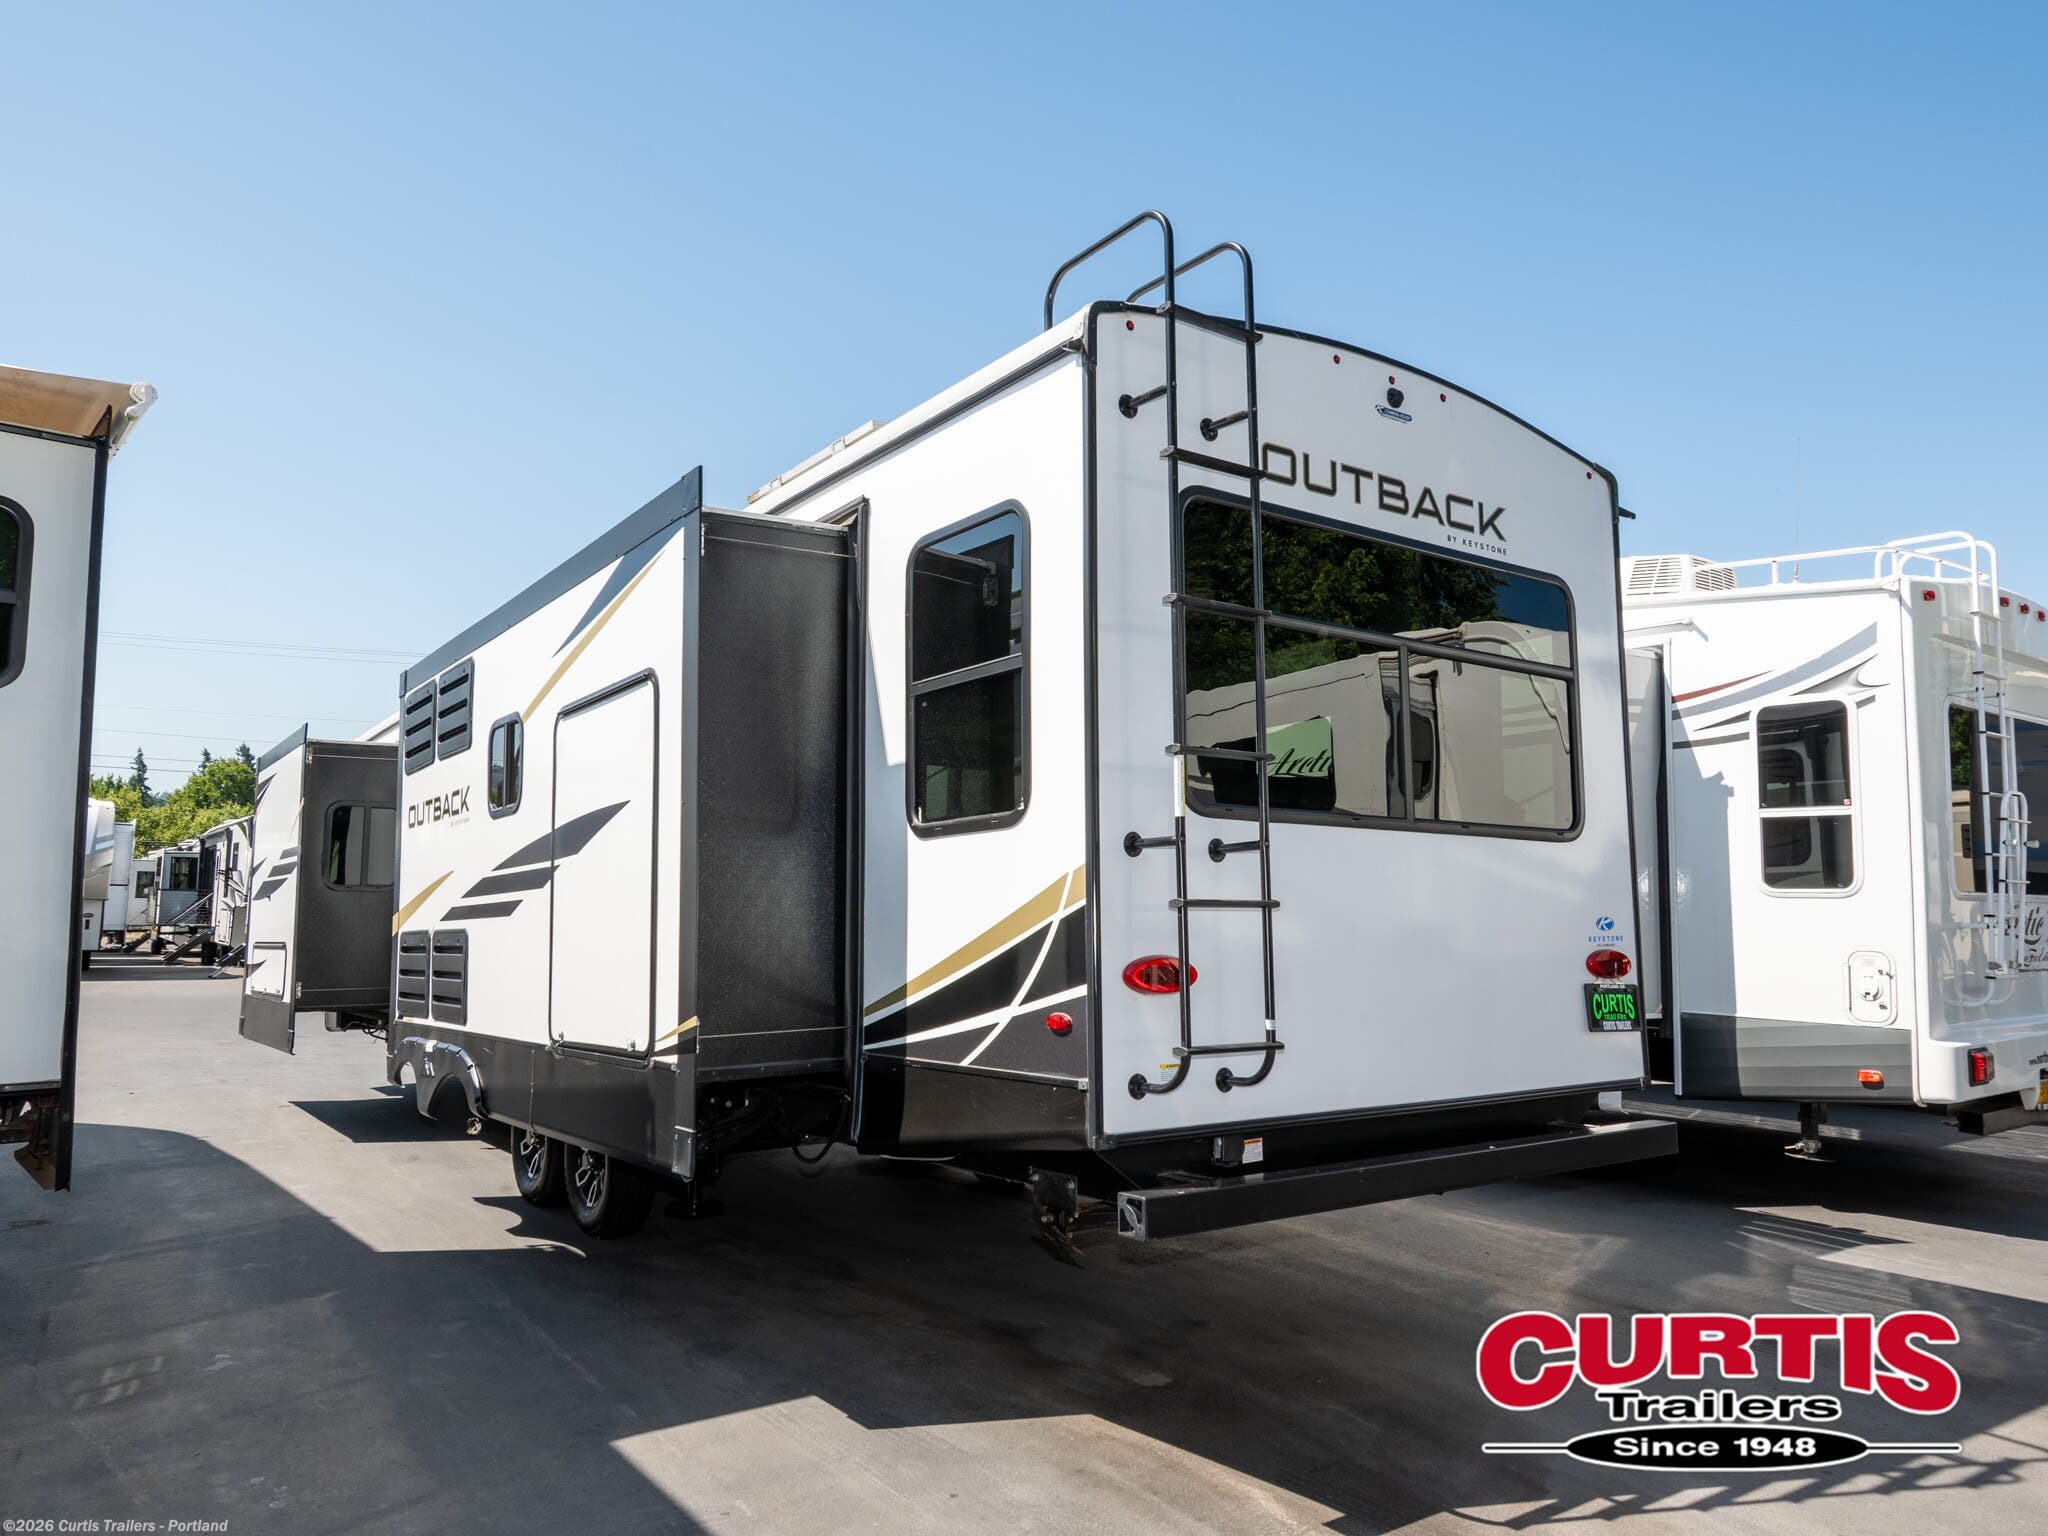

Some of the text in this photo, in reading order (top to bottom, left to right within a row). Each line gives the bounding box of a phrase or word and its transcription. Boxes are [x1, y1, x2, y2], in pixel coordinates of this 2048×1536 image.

[1261, 441, 1507, 543] OUTBACK
[1446, 534, 1508, 556] BY KEYSTONE
[408, 785, 470, 829] OUTBACK
[1593, 993, 1635, 1020] CURTIS
